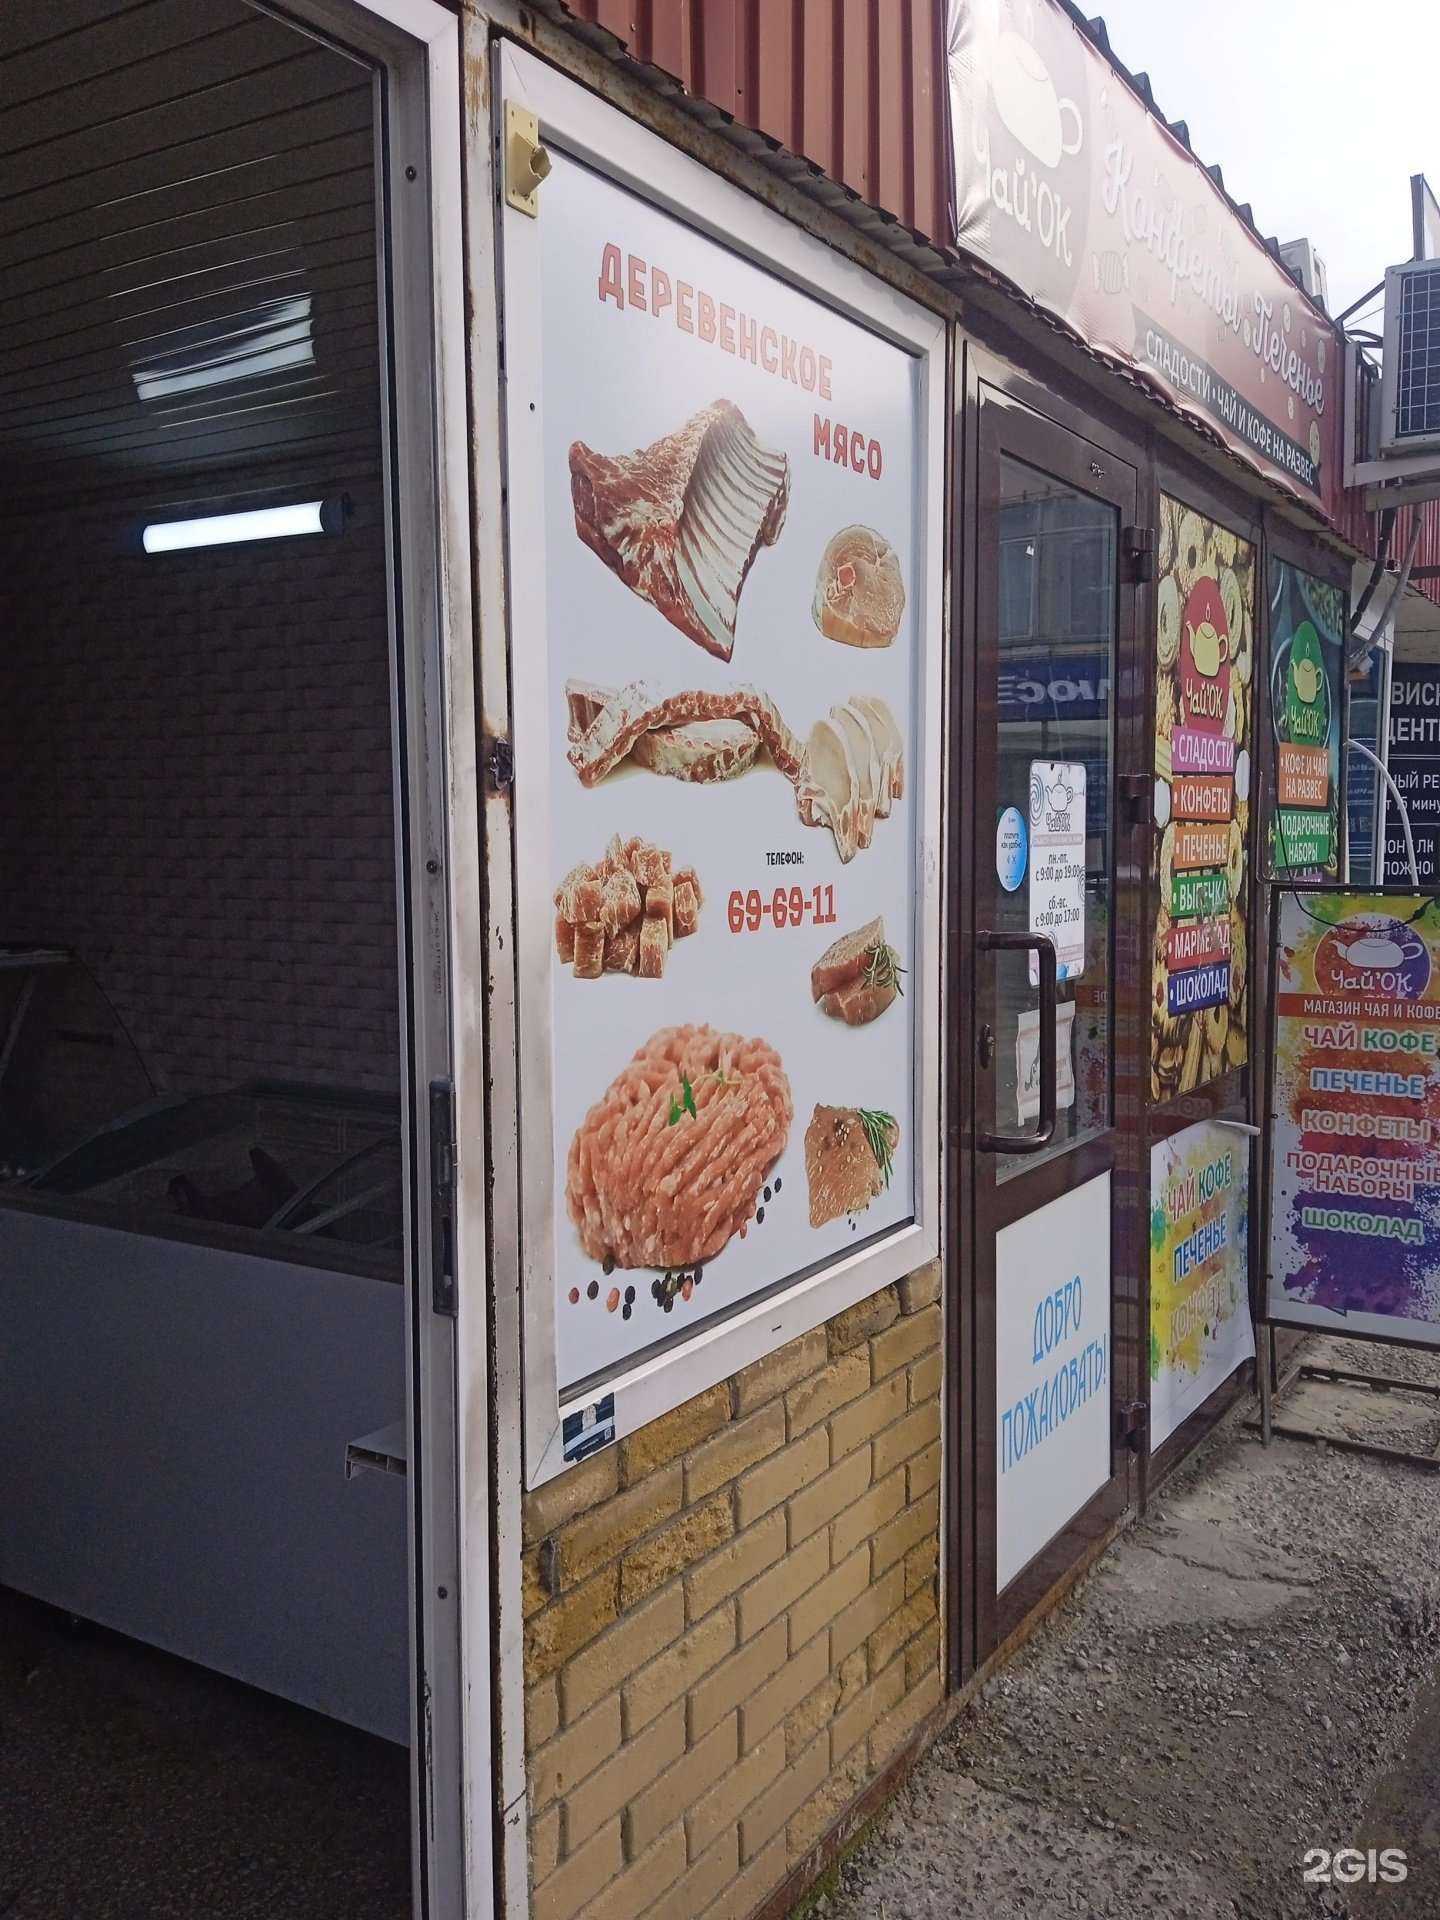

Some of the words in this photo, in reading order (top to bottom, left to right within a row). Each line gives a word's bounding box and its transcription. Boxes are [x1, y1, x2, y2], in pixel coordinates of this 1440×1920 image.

[598, 242, 833, 401] ДЕРЕВЕНСКОЕ
[1251, 291, 1324, 415] Печенье
[1146, 330, 1210, 402] СЛАДОСТИ
[1217, 385, 1238, 424] ЧАЙ
[1238, 407, 1247, 431] И
[1247, 414, 1272, 452] КОФЕ
[1273, 432, 1286, 464] НА
[1286, 446, 1314, 485] РАЗВЕС
[813, 413, 883, 480] МЯСО
[1178, 734, 1234, 771] СЛАДОСТИ
[1284, 752, 1305, 774] КОФЕ
[1306, 756, 1312, 776] И
[1313, 753, 1328, 777] ЧАЙ
[1180, 784, 1230, 813] КОНФЕТЫ
[1286, 777, 1296, 798] НА
[1297, 779, 1322, 799] РАЗВЕС
[1281, 815, 1330, 840] ПОДАРОЧНЫЕ
[766, 852, 805, 865] ТЕЛЕФОН:
[1182, 834, 1227, 862] ПЕЧЕНЬЕ
[1288, 842, 1318, 862] НАБОРЫ
[1035, 870, 1040, 881] с
[1055, 869, 1063, 882] до
[728, 884, 836, 933] 69-69-11
[1035, 916, 1039, 927] с
[1054, 913, 1063, 927] до
[1064, 908, 1080, 922] 17:00
[1175, 924, 1230, 959] МАРМЕАД
[1176, 968, 1229, 1006] ШОКОЛАД
[1330, 969, 1413, 992] Чай'ОК
[1304, 999, 1361, 1016] МАГАЗИН
[1364, 1003, 1389, 1017] ЧАЯ
[1393, 1004, 1402, 1018] И
[1304, 1023, 1355, 1049] ЧАЙ
[1363, 1030, 1434, 1053] КОФЕ
[1312, 1069, 1424, 1096] ПЕЧЕНЬЕ
[1303, 1111, 1429, 1141] КОНФЕТЫ
[1168, 1170, 1196, 1220] ЧАЙ
[1198, 1153, 1231, 1204] КОФЕ
[1316, 1173, 1412, 1200] НАБОРЫ
[1303, 1208, 1423, 1242] ШОКОЛАД
[1172, 1212, 1227, 1285] ПЕЧЕНЬЕ
[1032, 1275, 1082, 1365] ДОБРО
[1001, 1333, 1106, 1474] ПОЖАЛОВАТЬ!
